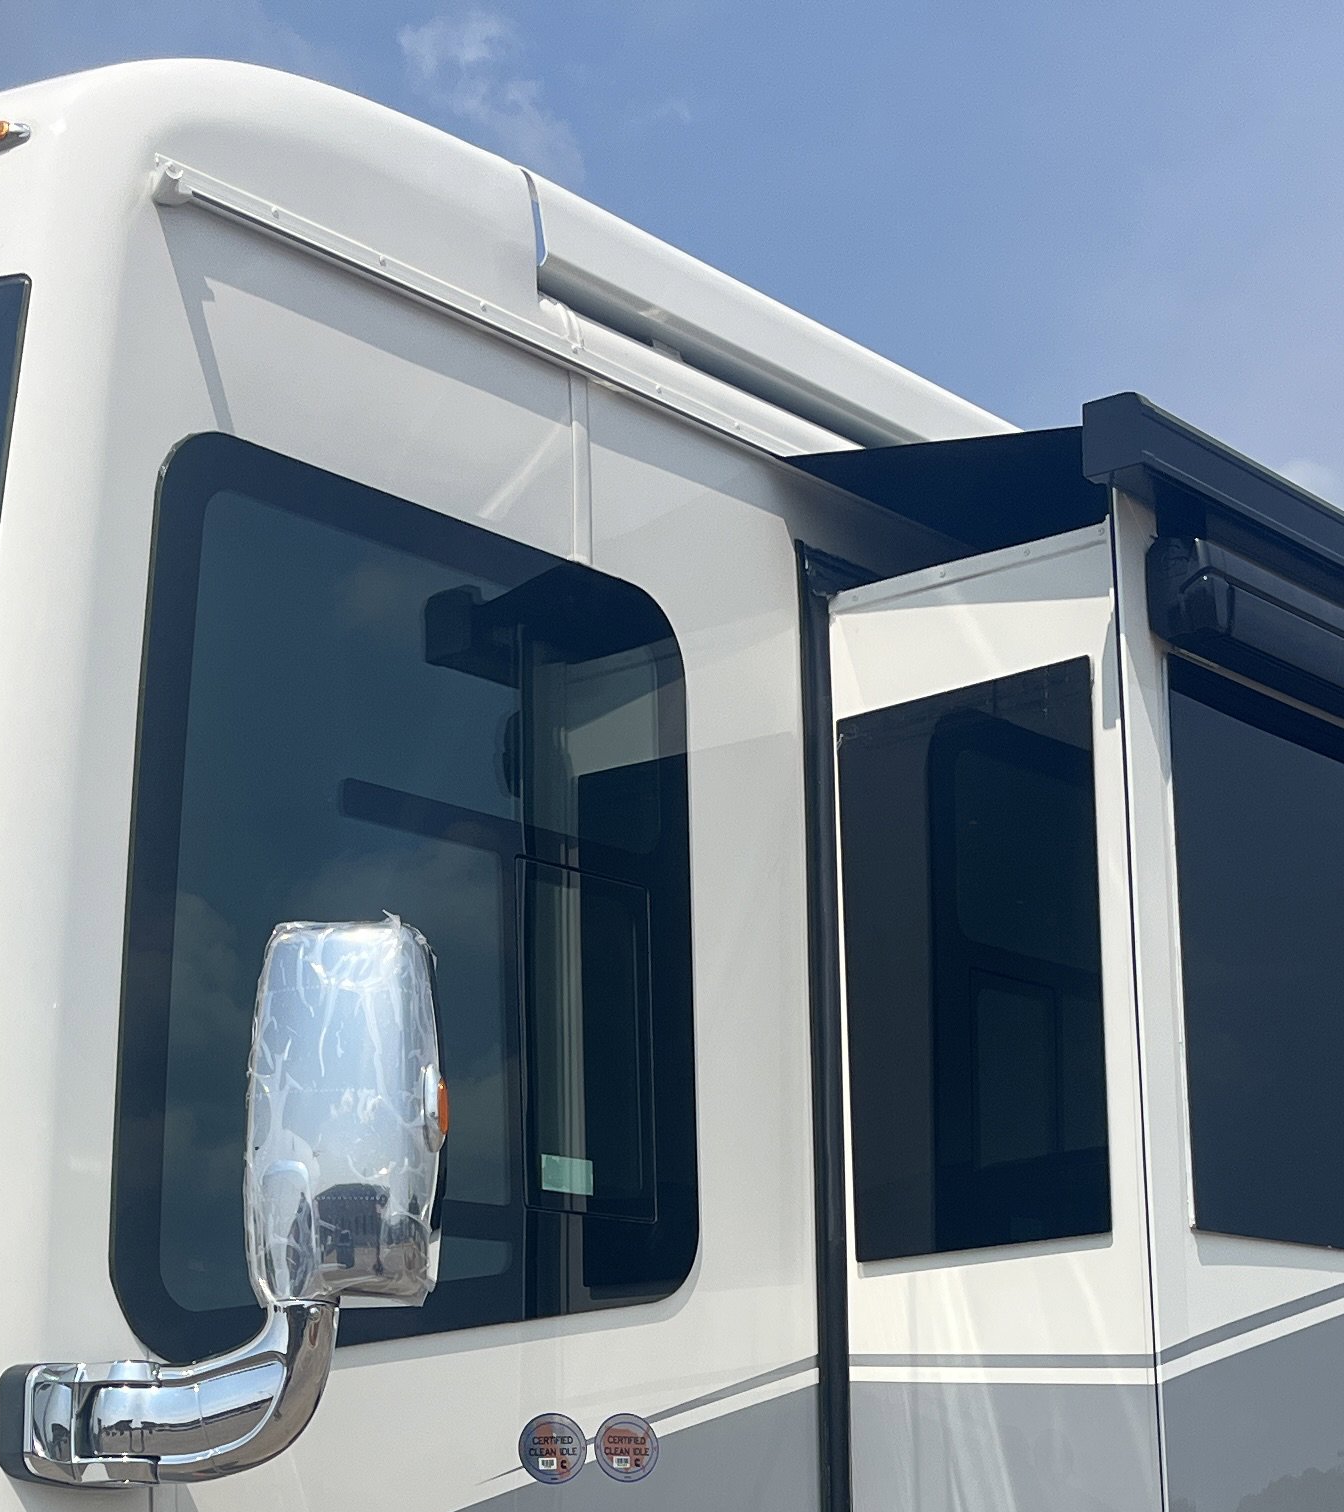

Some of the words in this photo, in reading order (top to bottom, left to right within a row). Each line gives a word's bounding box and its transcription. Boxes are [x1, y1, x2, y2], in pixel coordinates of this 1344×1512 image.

[532, 1435, 574, 1446] CERTIFIED
[607, 1435, 646, 1446] CERTIFIED
[529, 1447, 556, 1457] CLEAN
[559, 1447, 577, 1456] IDLE
[604, 1447, 630, 1456] CLEAN
[632, 1447, 650, 1457] IDLE
